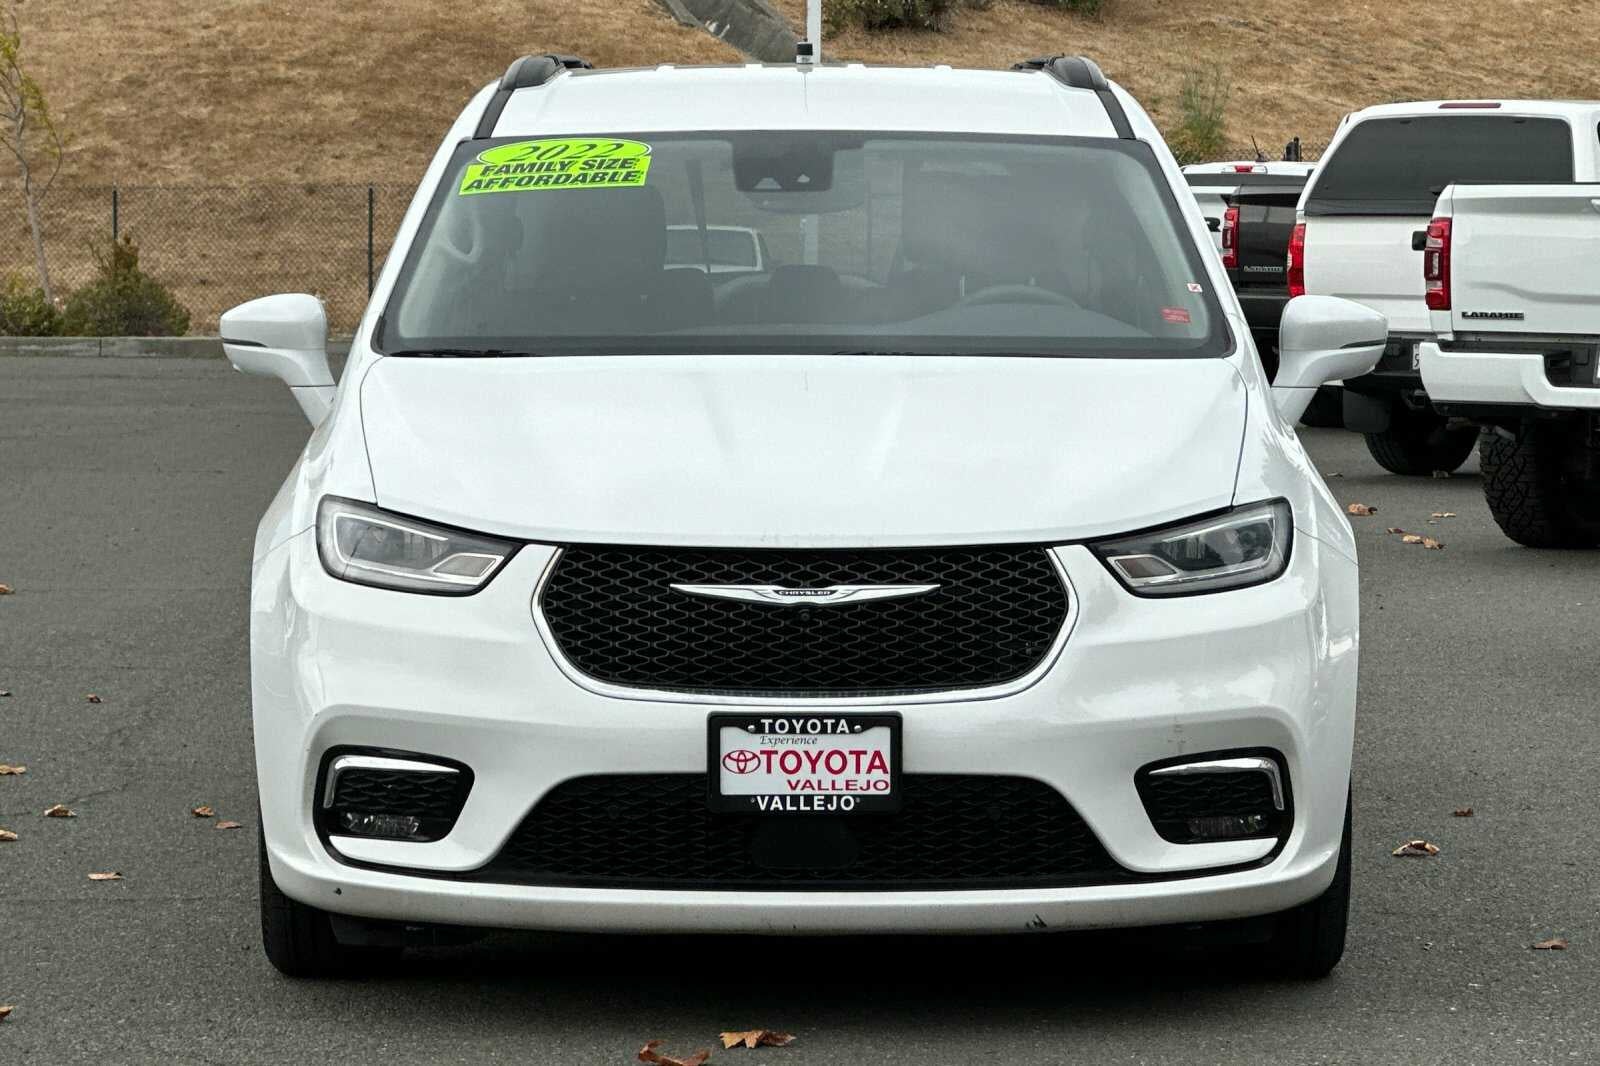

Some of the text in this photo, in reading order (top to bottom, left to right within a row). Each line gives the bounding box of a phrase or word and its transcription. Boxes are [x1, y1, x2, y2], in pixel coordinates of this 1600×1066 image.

[505, 142, 625, 162] 2022
[480, 157, 640, 177] FAMILY SIZE
[464, 170, 644, 192] AFFORDABLE
[1461, 311, 1525, 321] LARAMIE
[760, 718, 850, 734] TOYOTA
[759, 735, 818, 748] Experience
[759, 749, 889, 775] TOYOTA
[786, 779, 890, 792] VALLEJO
[756, 795, 856, 811] VALLEJO
